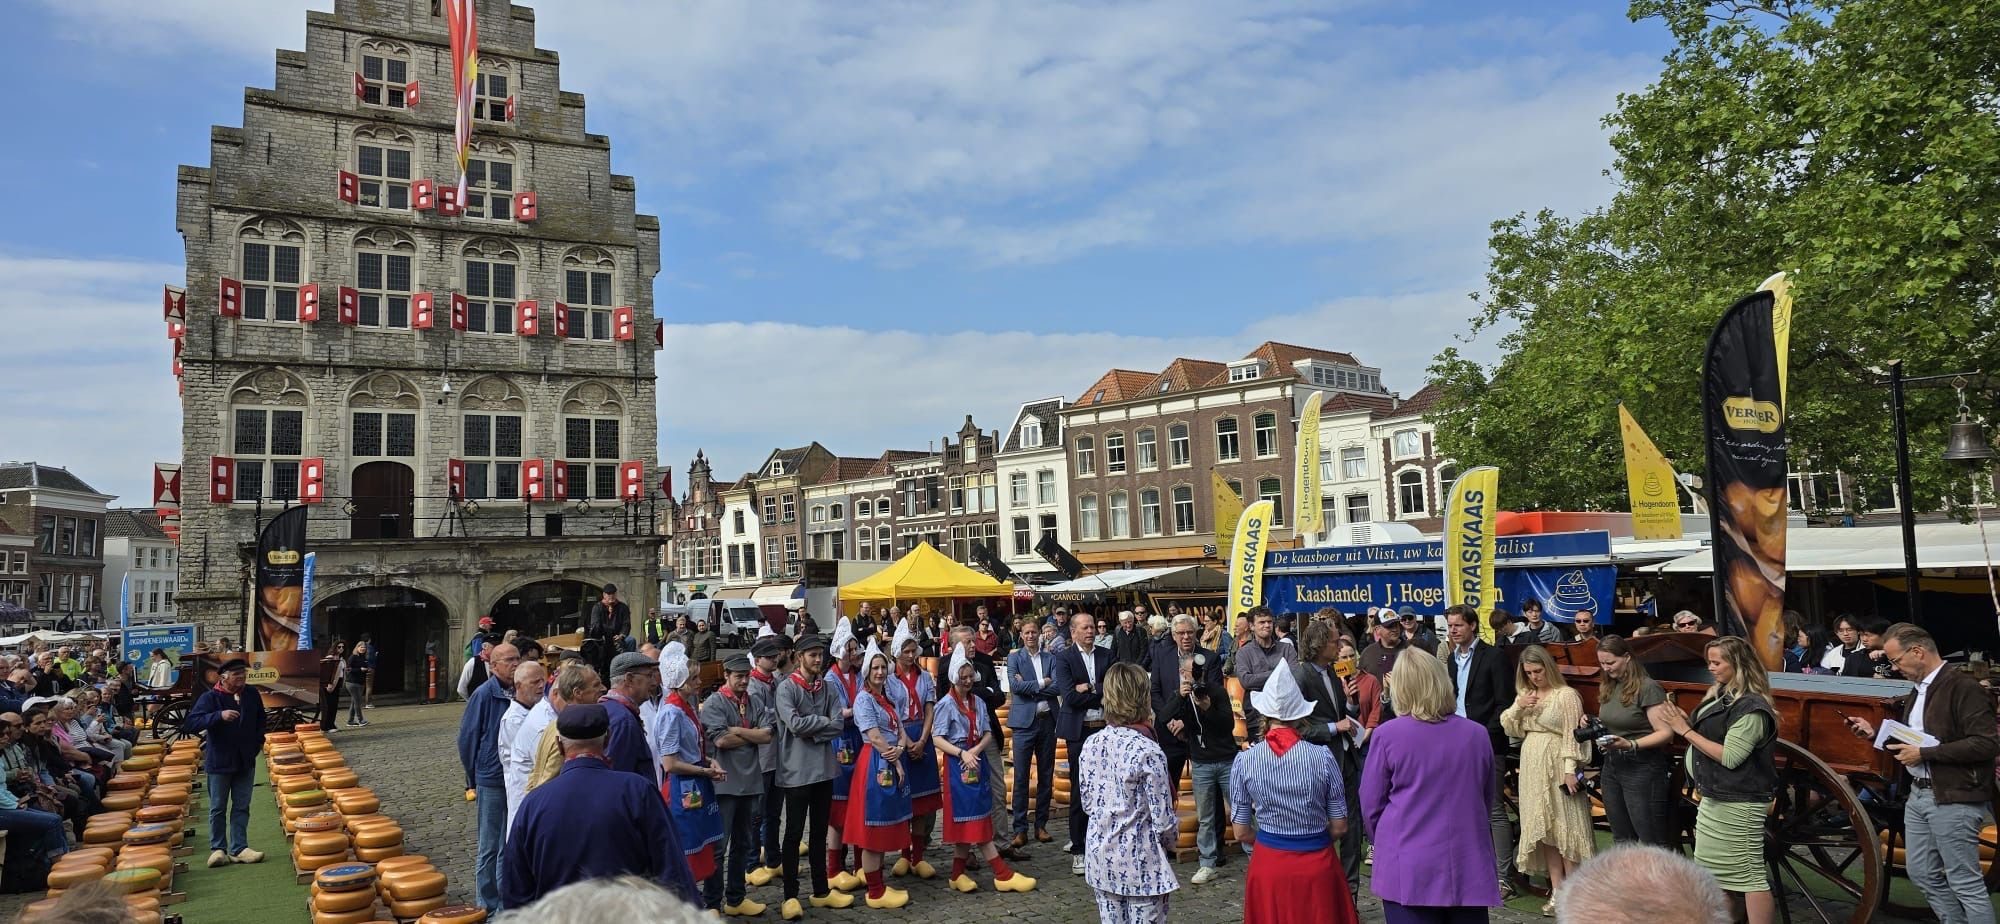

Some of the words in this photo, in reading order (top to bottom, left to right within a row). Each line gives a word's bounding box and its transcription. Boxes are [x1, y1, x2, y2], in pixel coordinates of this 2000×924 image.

[1639, 500, 1676, 509] Hogendoorn
[1274, 553, 1288, 564] De
[1291, 551, 1341, 564] kaasboer
[1345, 550, 1361, 561] uit
[1366, 547, 1399, 561] Vlist,
[1403, 549, 1422, 559] uw
[1462, 490, 1484, 608] GRASKAAS
[1241, 518, 1261, 608] GRASKAAS
[1053, 593, 1083, 601] CANNOLI
[1296, 584, 1372, 602] Kaashandel
[1385, 583, 1397, 607] J.
[248, 671, 277, 679] RGEER
